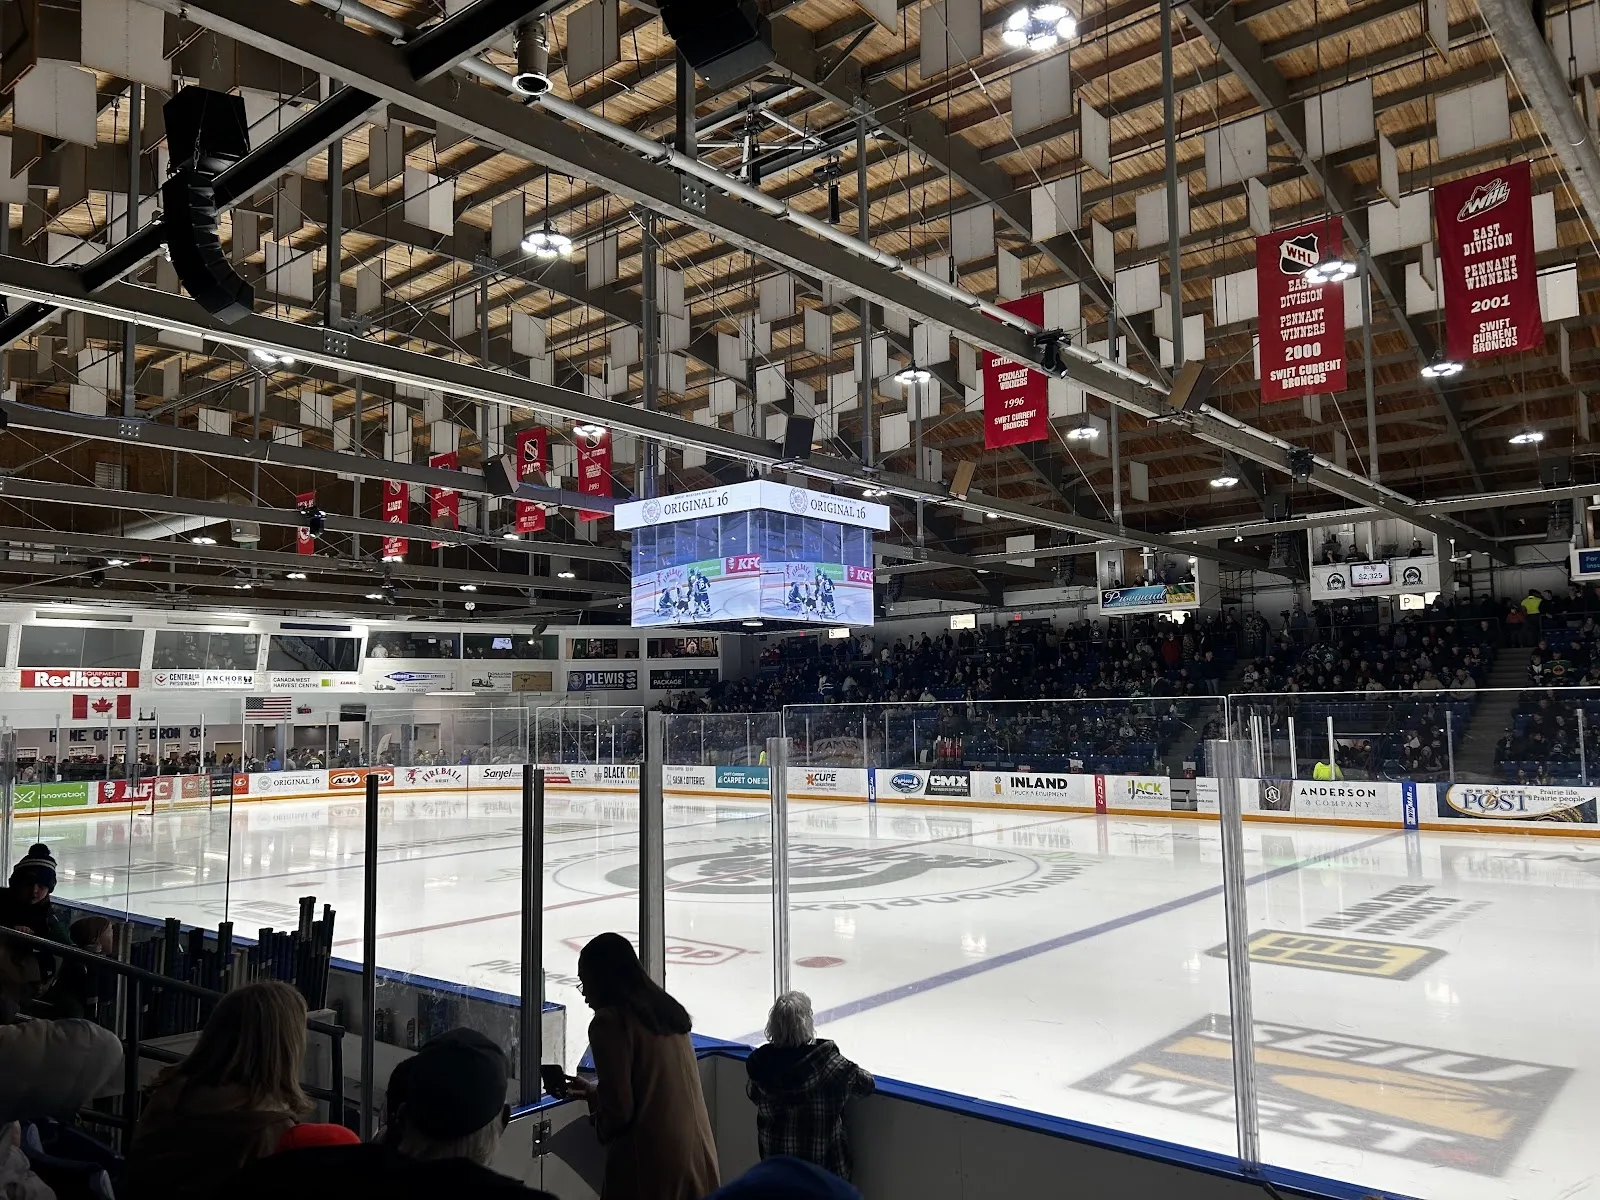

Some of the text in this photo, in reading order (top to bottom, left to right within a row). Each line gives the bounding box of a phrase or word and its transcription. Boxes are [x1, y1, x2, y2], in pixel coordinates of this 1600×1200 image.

[1473, 223, 1500, 241] EAST
[1463, 233, 1513, 256] DIVISION
[1286, 245, 1314, 265] WHL
[1464, 255, 1517, 279] PENNANT
[1465, 268, 1518, 290] WINNERS
[1280, 288, 1323, 309] DIVISION
[1471, 294, 1511, 313] 2001
[1280, 308, 1324, 327] PENNANT
[1479, 318, 1510, 333] SWIFT
[1280, 322, 1325, 341] WINNERS
[1473, 326, 1517, 344] CURRENT
[1285, 342, 1321, 362] 2000
[1472, 336, 1518, 354] BRONCOS
[998, 368, 1029, 383] PENNANT
[1270, 359, 1341, 381] SWIFT CURRENT
[999, 377, 1028, 391] WINNERS
[1282, 373, 1326, 390] BRONCOS
[1004, 396, 1024, 409] 1996
[994, 409, 1036, 425] SWIFT CURRENT
[1003, 419, 1029, 431] BRONCOS
[664, 491, 728, 515] ORIGINAL 16
[811, 499, 866, 519] ORIGINAL 16
[1104, 588, 1168, 604] Provincial
[34, 671, 128, 687] Redhead
[586, 673, 624, 684] PLEWIS
[49, 729, 87, 742] HME
[117, 729, 144, 740] TE
[150, 726, 207, 740] BRONOS
[334, 776, 358, 784] A&W
[421, 767, 462, 783] FIREBALL
[483, 768, 512, 780] Sanjel
[571, 770, 584, 778] ETG
[603, 766, 640, 779] BLACK GOL
[723, 776, 745, 784] CARPET
[815, 773, 836, 781] CUPE
[273, 779, 310, 787] ORIGINAL
[312, 776, 320, 785] 16
[930, 775, 968, 787] CMX
[1010, 776, 1068, 790] INLAND
[1300, 787, 1376, 798] ANDERSON
[1315, 800, 1370, 808] COMPANY
[1461, 792, 1529, 812] POST
[1197, 1027, 1552, 1082] SEIU
[1100, 1072, 1457, 1152] WEST
